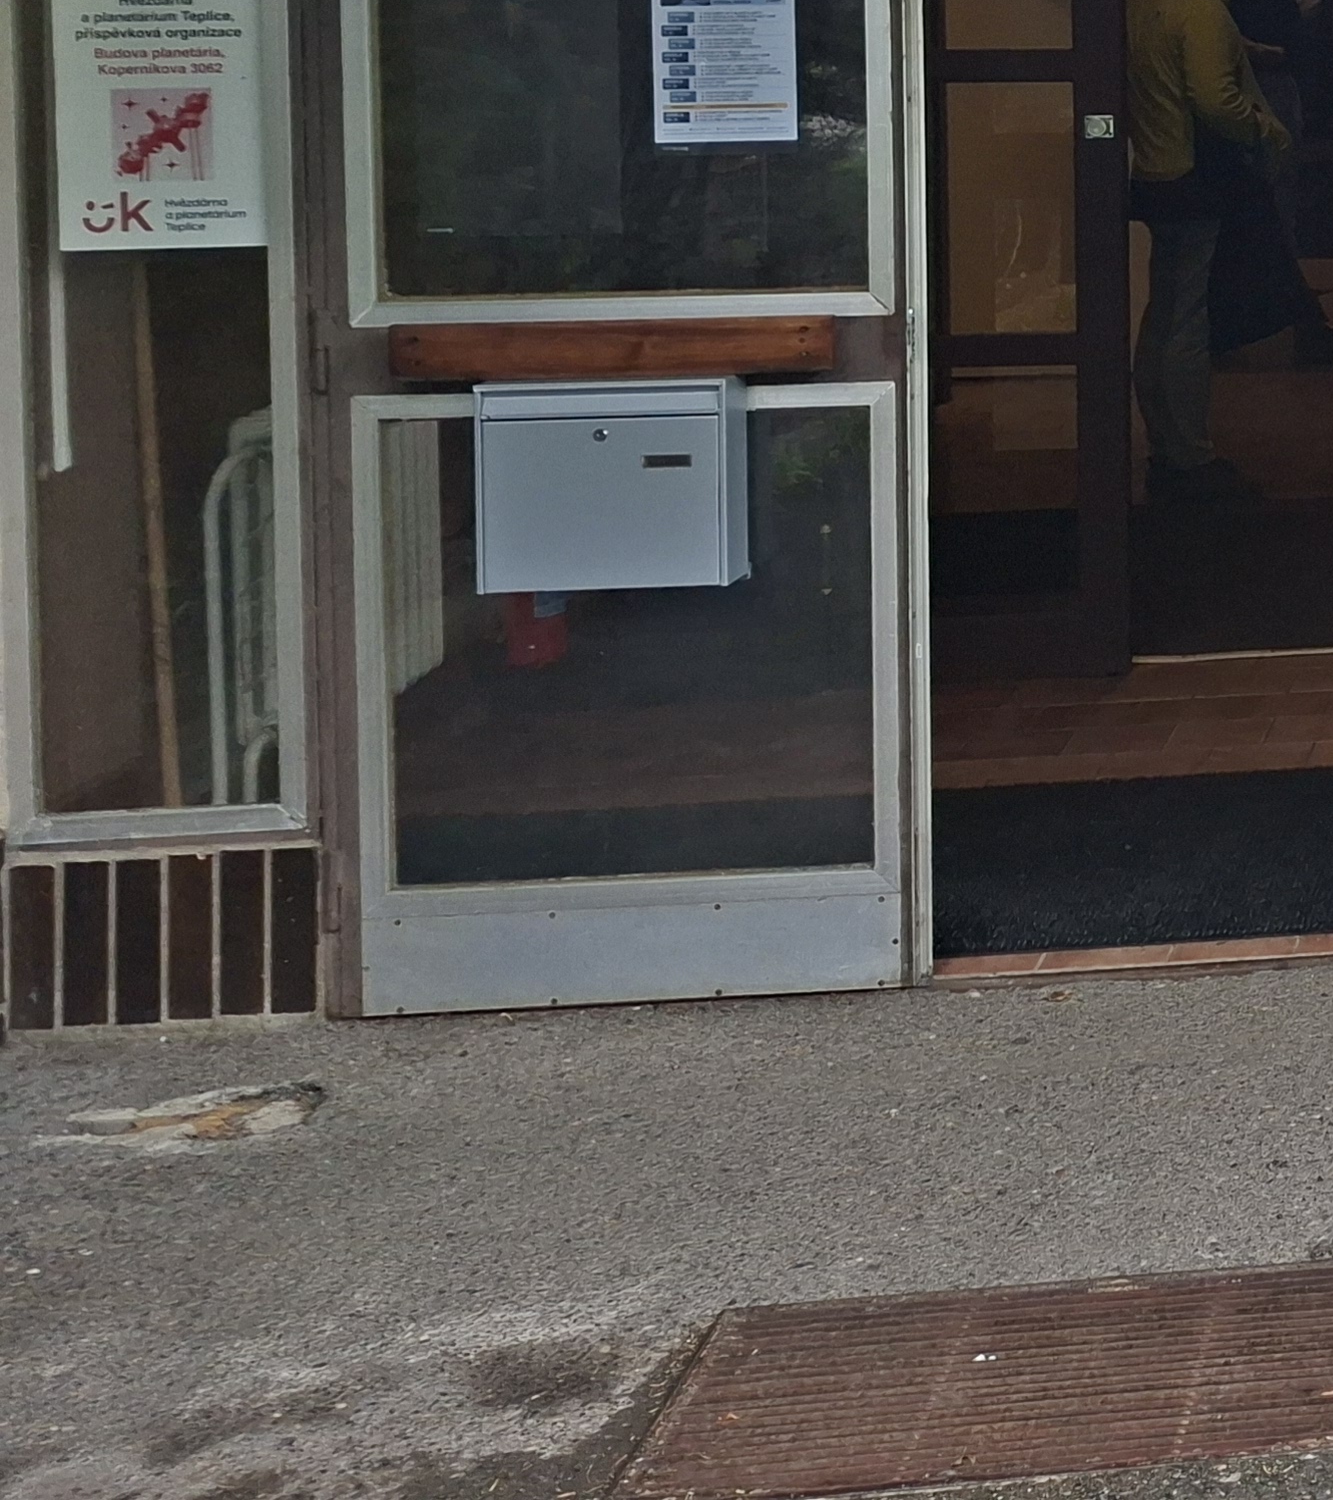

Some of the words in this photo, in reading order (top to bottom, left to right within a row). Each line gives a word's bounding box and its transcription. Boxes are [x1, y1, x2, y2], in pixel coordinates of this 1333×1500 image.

[81, 15, 90, 23] a
[94, 11, 177, 24] planetárium
[182, 10, 235, 22] Teplice,
[75, 27, 162, 40] příspěvková
[165, 28, 242, 39] organizace
[94, 47, 148, 59] Budova
[191, 62, 223, 74] 3062
[164, 197, 228, 207] Hvězdárna
[175, 208, 246, 221] planetárium
[166, 222, 206, 233] Teplice
